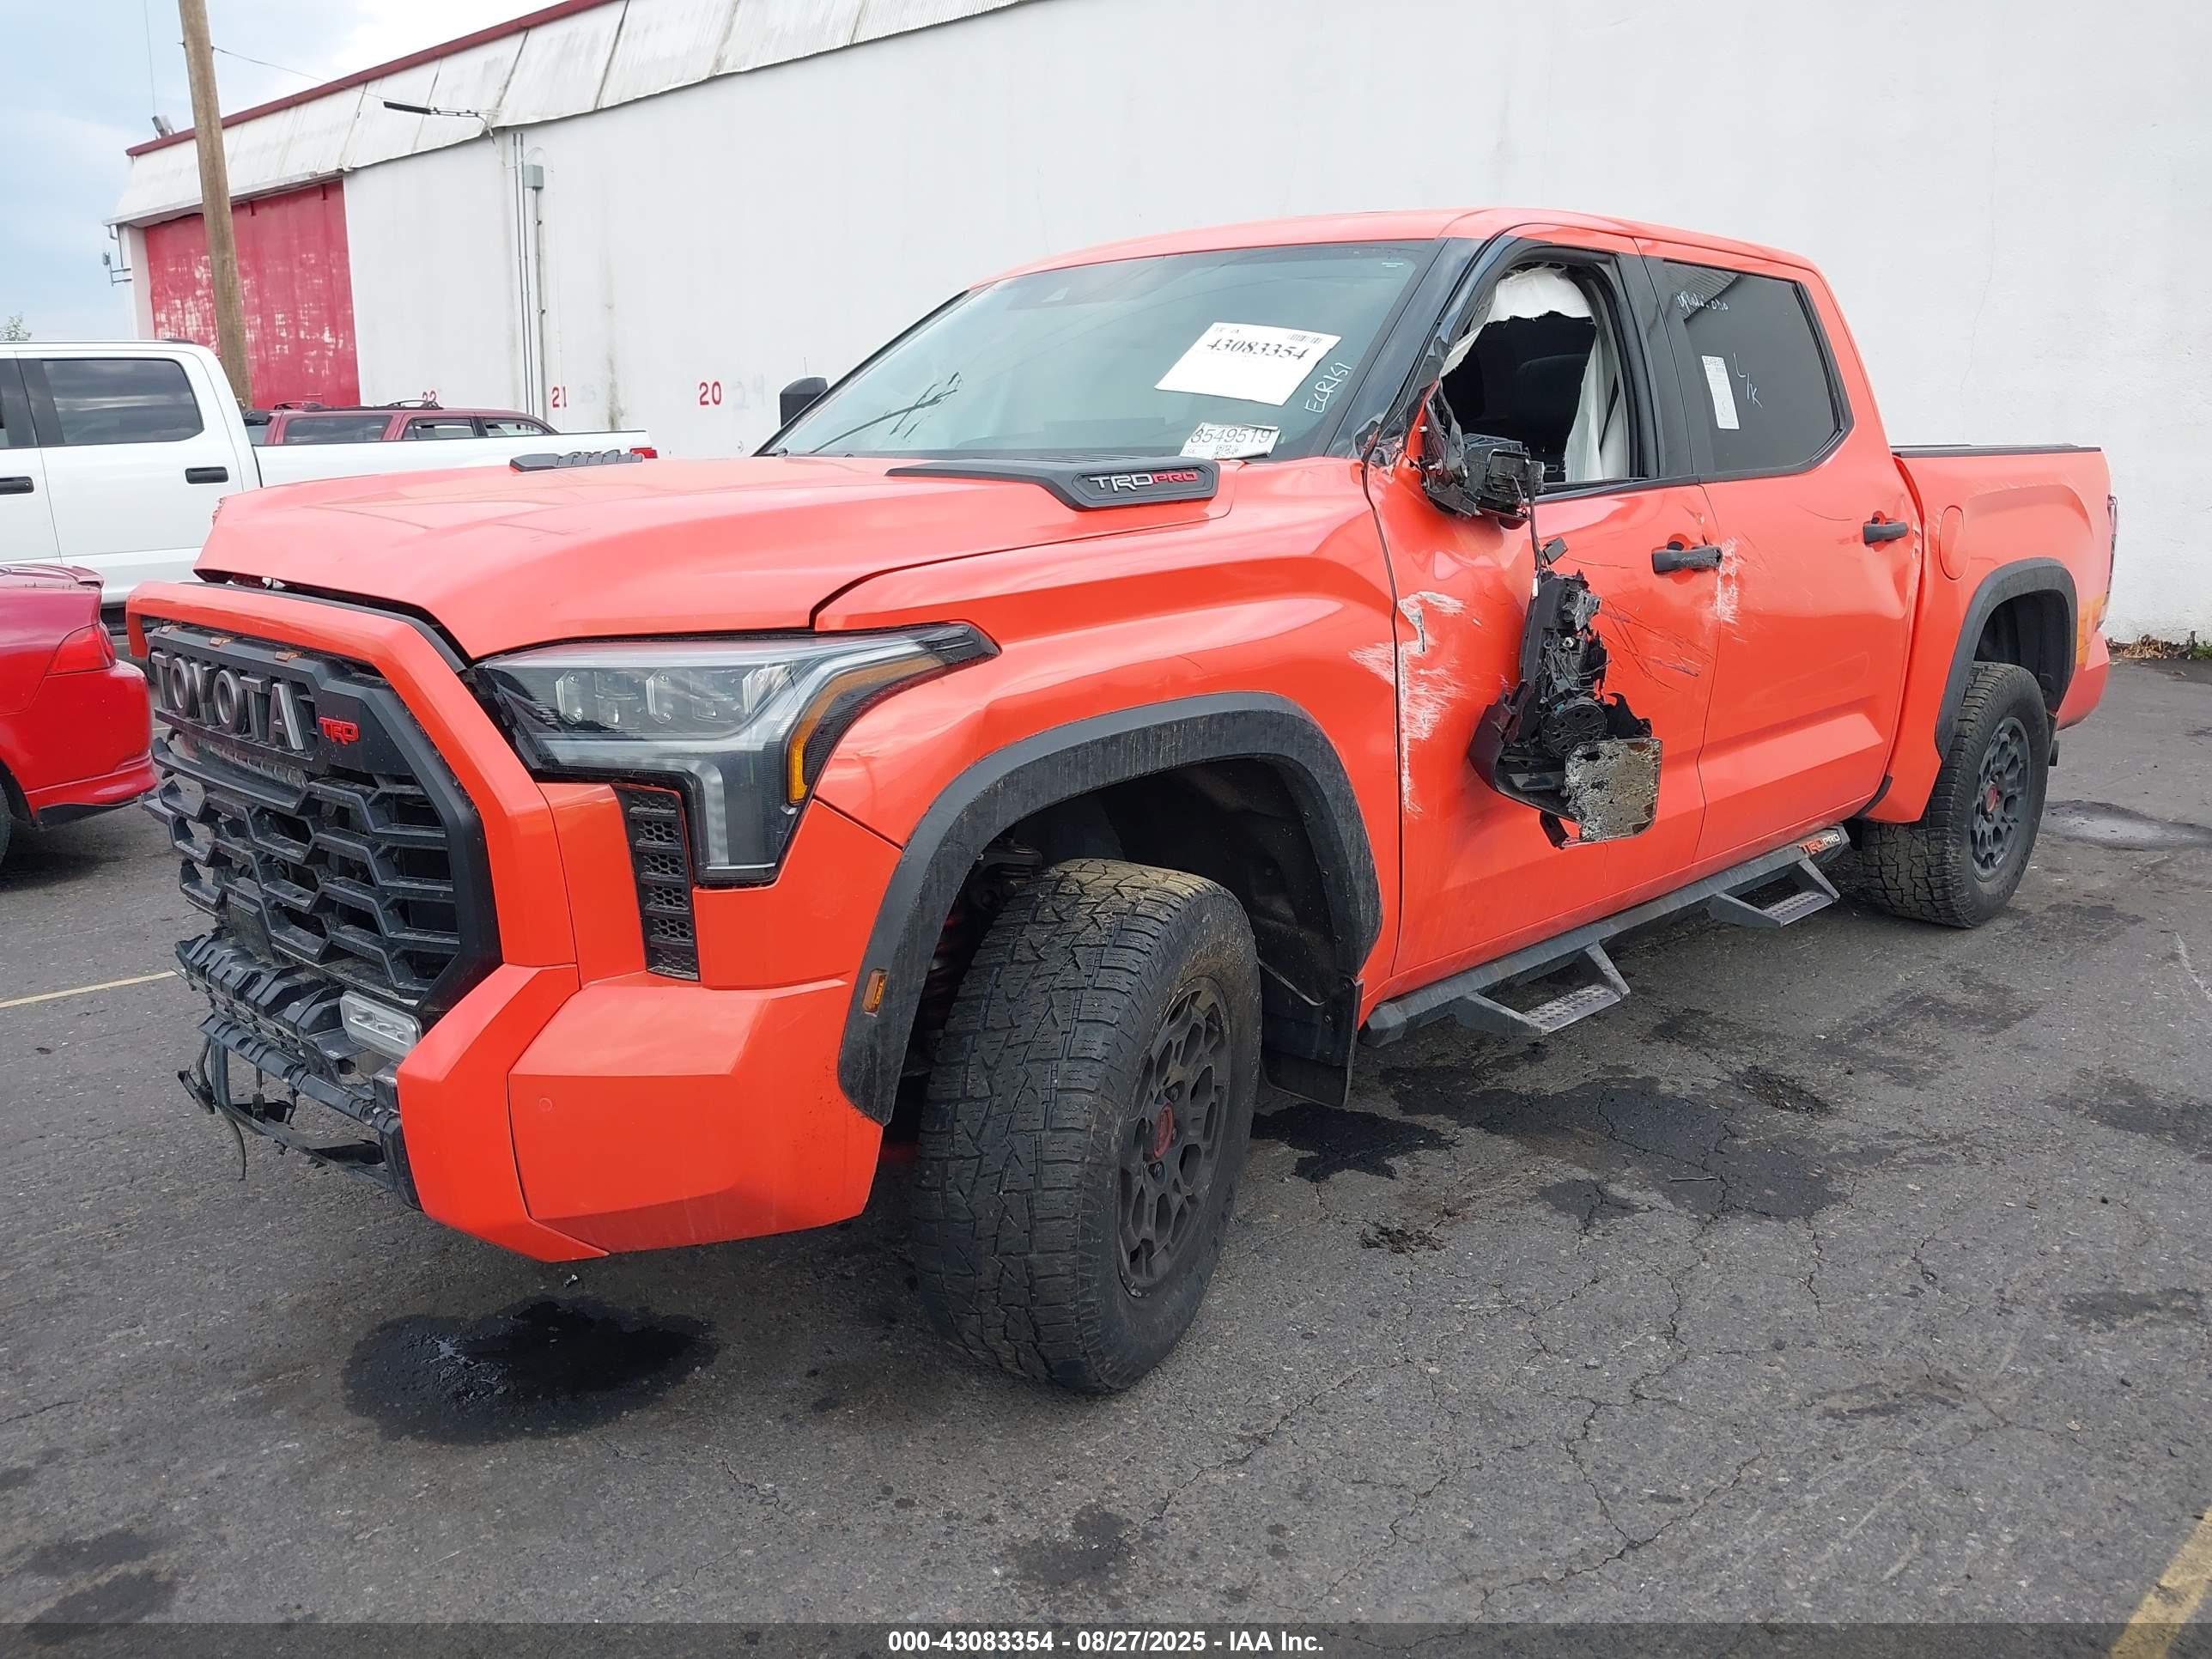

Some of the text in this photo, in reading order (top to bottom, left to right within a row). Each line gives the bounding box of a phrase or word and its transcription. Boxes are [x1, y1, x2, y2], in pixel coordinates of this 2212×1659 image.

[1207, 338, 1310, 360] 43083354
[551, 386, 568, 408] 21
[699, 381, 721, 405] 20
[1089, 471, 1199, 492] TRD PRO
[151, 651, 305, 750] TOYOTA
[319, 716, 360, 745] TRD
